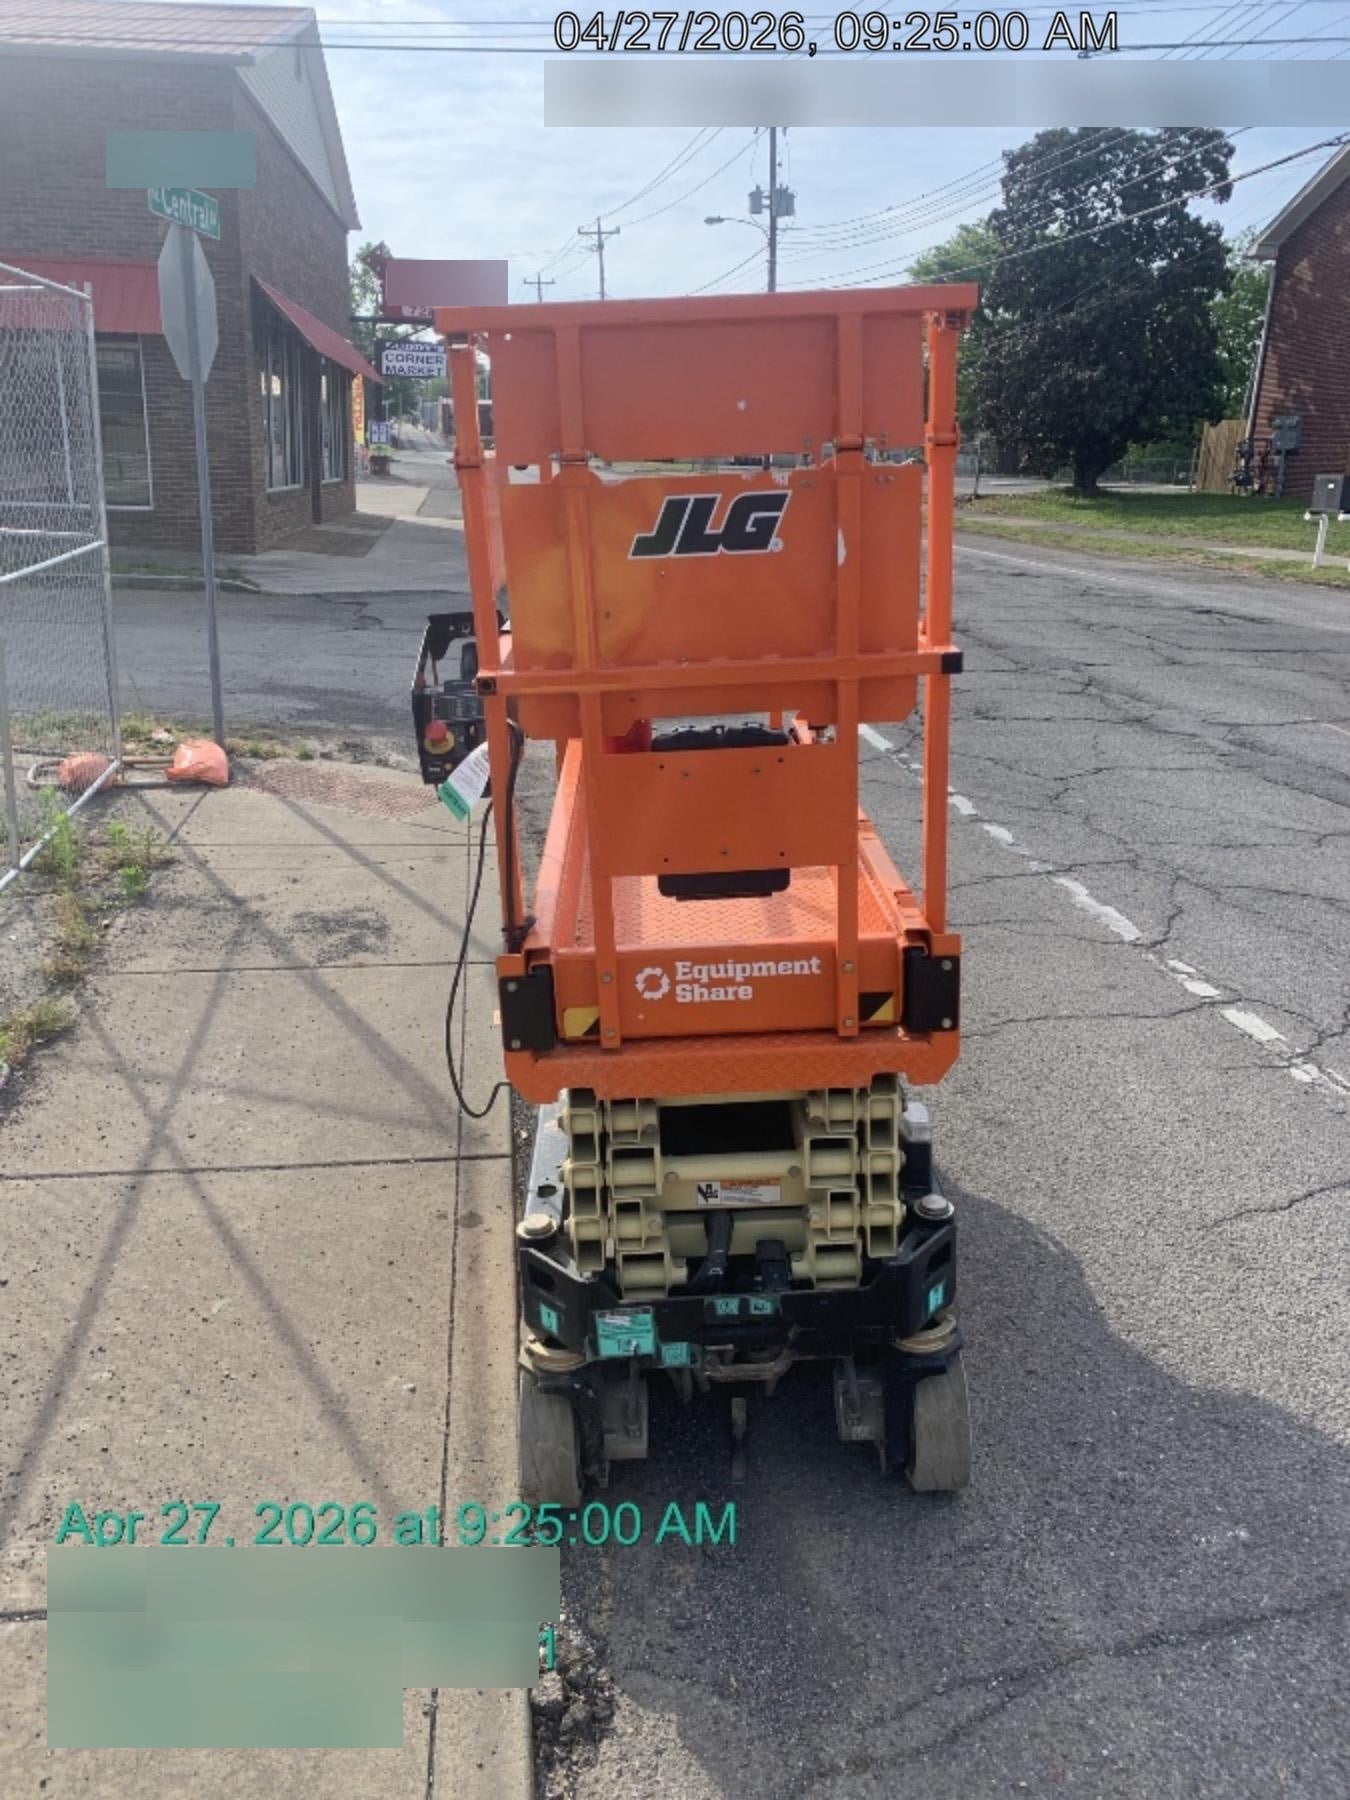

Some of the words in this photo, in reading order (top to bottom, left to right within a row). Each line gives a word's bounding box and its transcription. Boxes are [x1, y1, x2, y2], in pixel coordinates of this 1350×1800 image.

[161, 187, 209, 230] Central
[384, 365, 443, 376] MARKET
[385, 353, 444, 365] CORNER
[627, 490, 792, 560] JLG
[674, 956, 822, 983] Equipment
[674, 983, 753, 1003] Share
